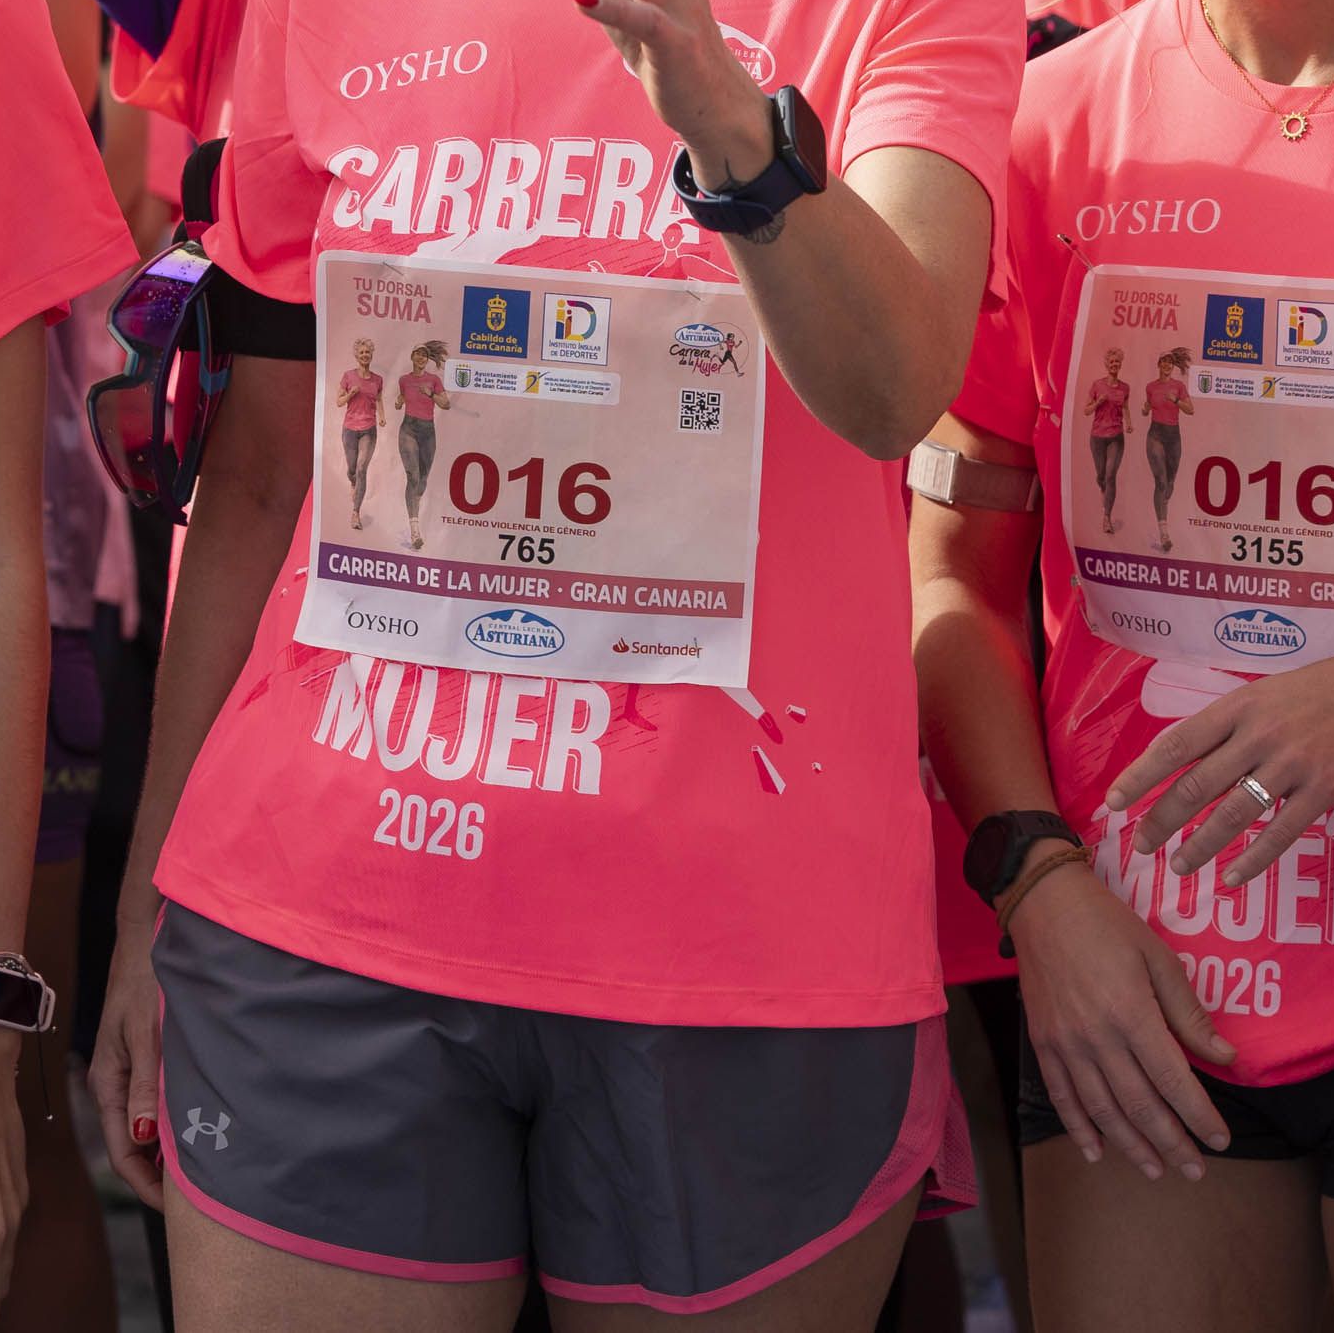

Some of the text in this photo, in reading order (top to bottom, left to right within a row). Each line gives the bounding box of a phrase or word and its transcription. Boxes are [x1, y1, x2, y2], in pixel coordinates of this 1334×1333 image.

[340, 40, 487, 101] OYSHO
[1076, 197, 1221, 242] OYSHO
[354, 277, 432, 298] TU DORSAL
[1115, 290, 1180, 307] TU DORSAL
[357, 293, 431, 323] SUMA
[1112, 304, 1178, 330] SUMA
[466, 341, 523, 354] Gran Canaria
[470, 333, 518, 344] Cabildo de
[549, 340, 601, 352] INSTITUTO INSULAR
[1211, 339, 1252, 350] Cabildo de
[560, 349, 598, 360] DEPORTES
[670, 344, 711, 358] Carrera
[1207, 348, 1258, 360] Gran Canaria
[449, 452, 612, 525] 016
[441, 516, 596, 538] TELÉFONO VIOLENCIA DE GÉNERO
[1188, 518, 1333, 538] TELÉFONO VIOLENCIA DE GÉNERO
[498, 534, 555, 565] 765
[1230, 535, 1304, 566] 3155
[328, 553, 727, 610] CARRERA DE LA MUJER GRAN CANARIA
[1084, 557, 1161, 584] CARRERA
[1167, 568, 1188, 588] DE
[1195, 571, 1217, 592] LA
[1224, 573, 1291, 599] MUJER
[348, 611, 419, 637] OYSHO
[1111, 611, 1171, 636] OYSHO
[473, 626, 557, 650] ASTURIANA
[1220, 626, 1299, 648] ASTURIANA
[631, 641, 702, 658] Santander
[311, 654, 612, 795] MUJER
[373, 788, 485, 860] 2026
